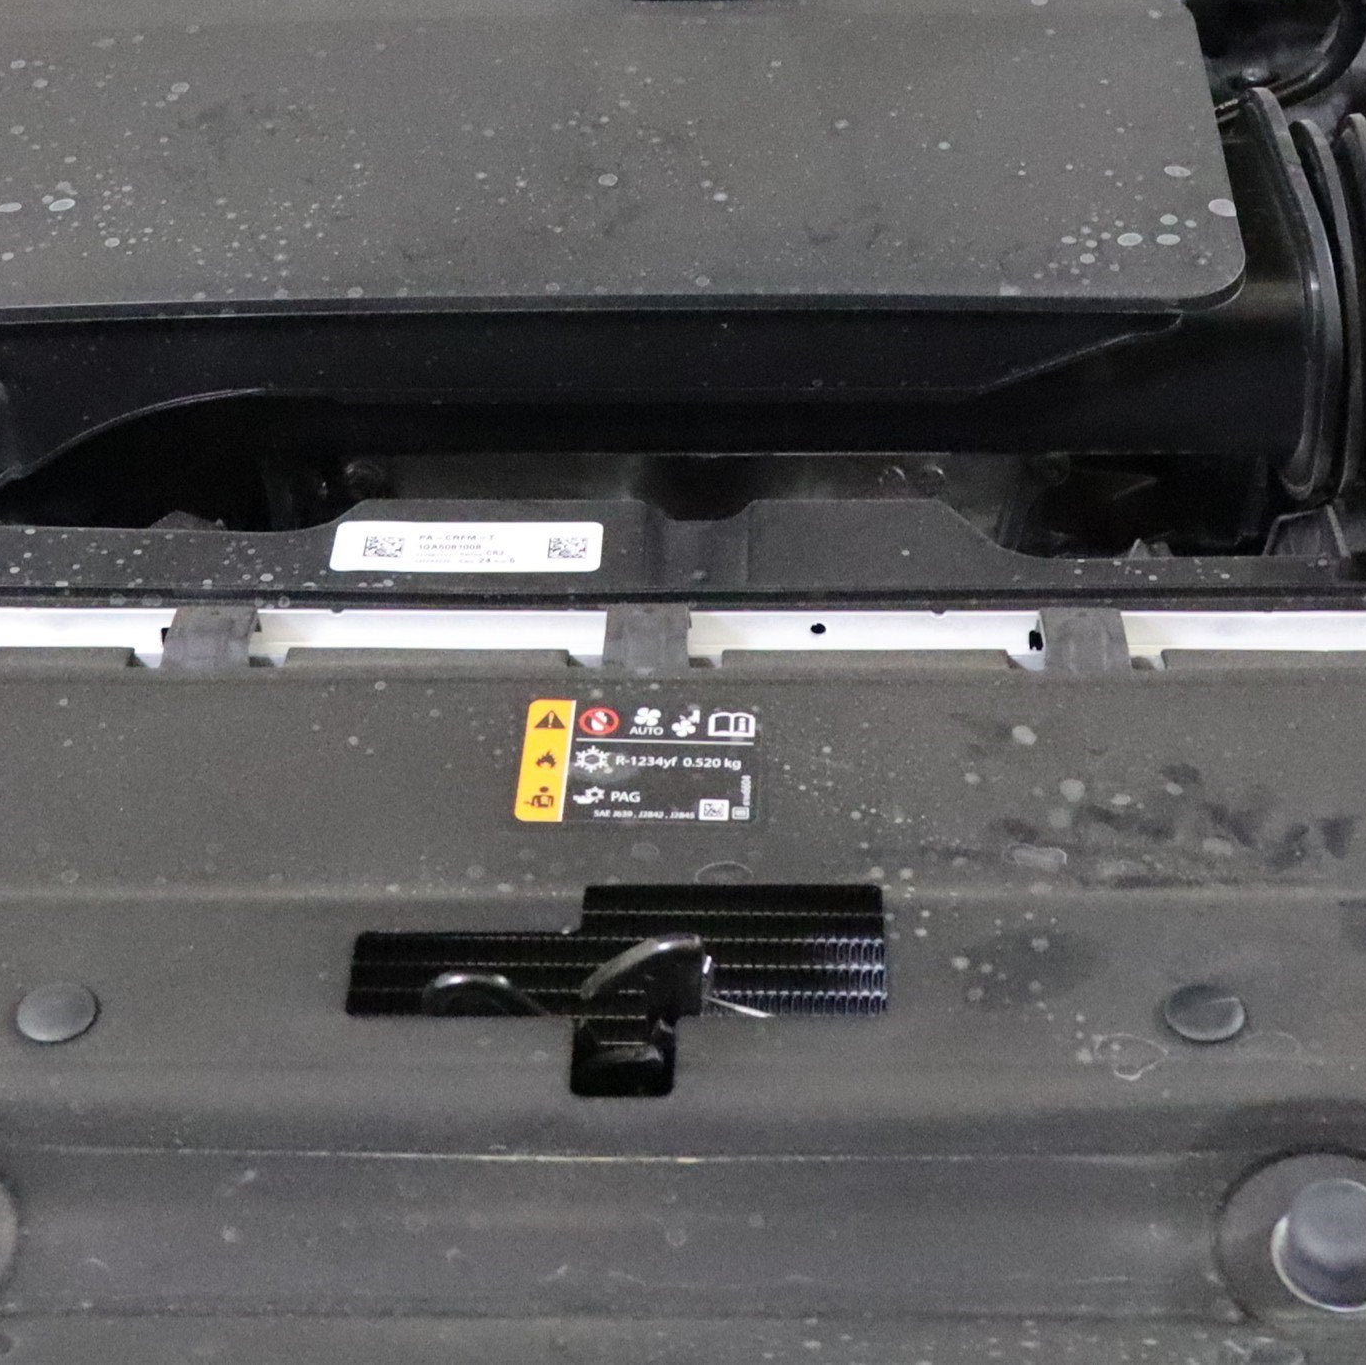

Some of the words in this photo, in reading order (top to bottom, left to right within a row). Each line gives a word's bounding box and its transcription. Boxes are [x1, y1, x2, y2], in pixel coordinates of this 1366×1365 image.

[629, 725, 664, 736] AUTO
[615, 755, 678, 768] R-1234yf
[682, 756, 721, 769] 0.520
[723, 756, 742, 771] kg
[610, 790, 641, 804] PAG
[593, 809, 611, 818] SAE
